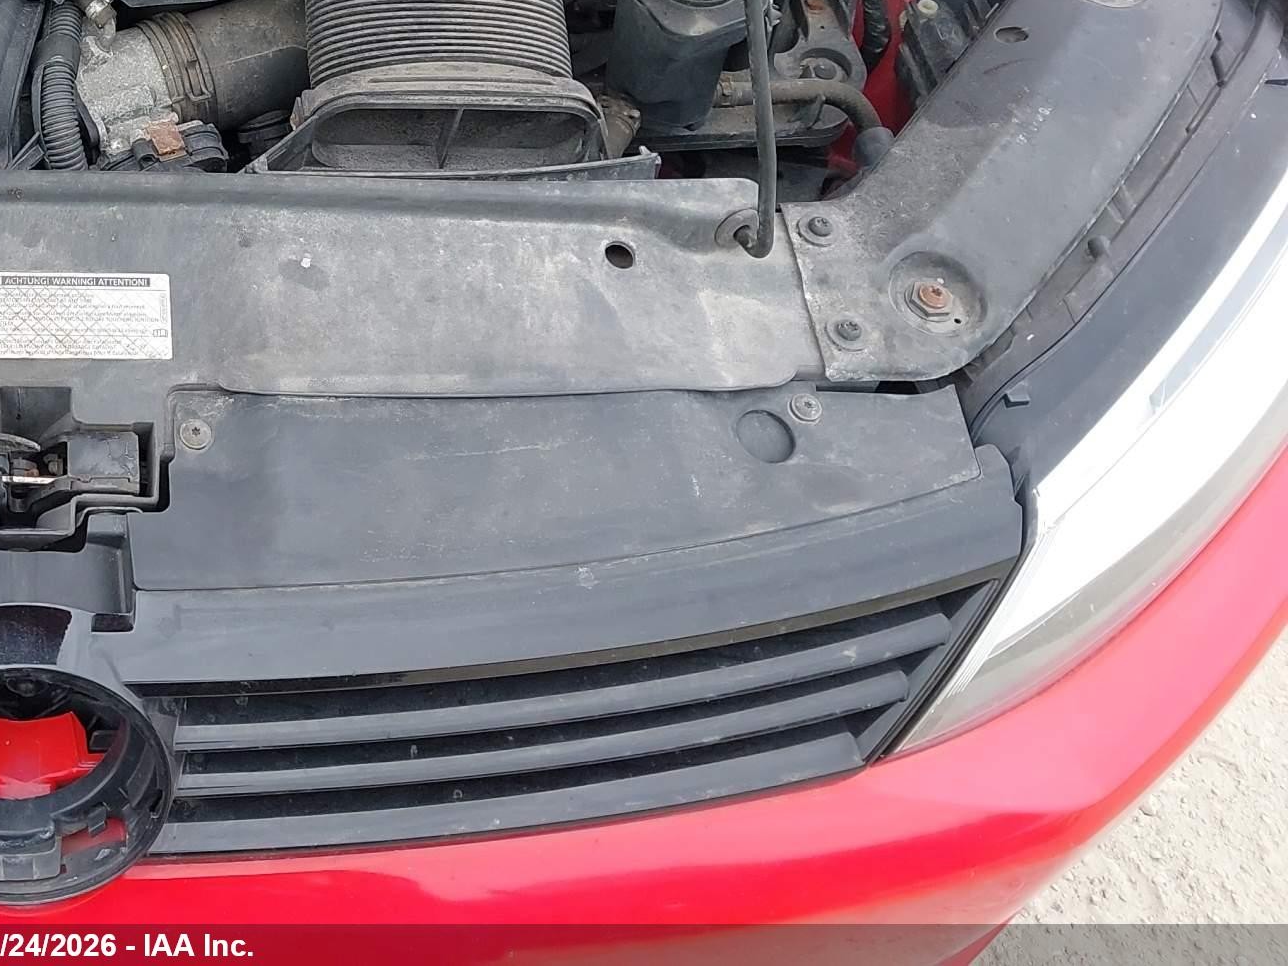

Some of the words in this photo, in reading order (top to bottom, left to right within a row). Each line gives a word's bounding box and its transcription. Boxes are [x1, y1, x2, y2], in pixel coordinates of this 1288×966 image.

[4, 276, 49, 286] ACHTUNG!
[51, 276, 96, 287] WARNING!
[97, 276, 148, 287] ATTENTION!
